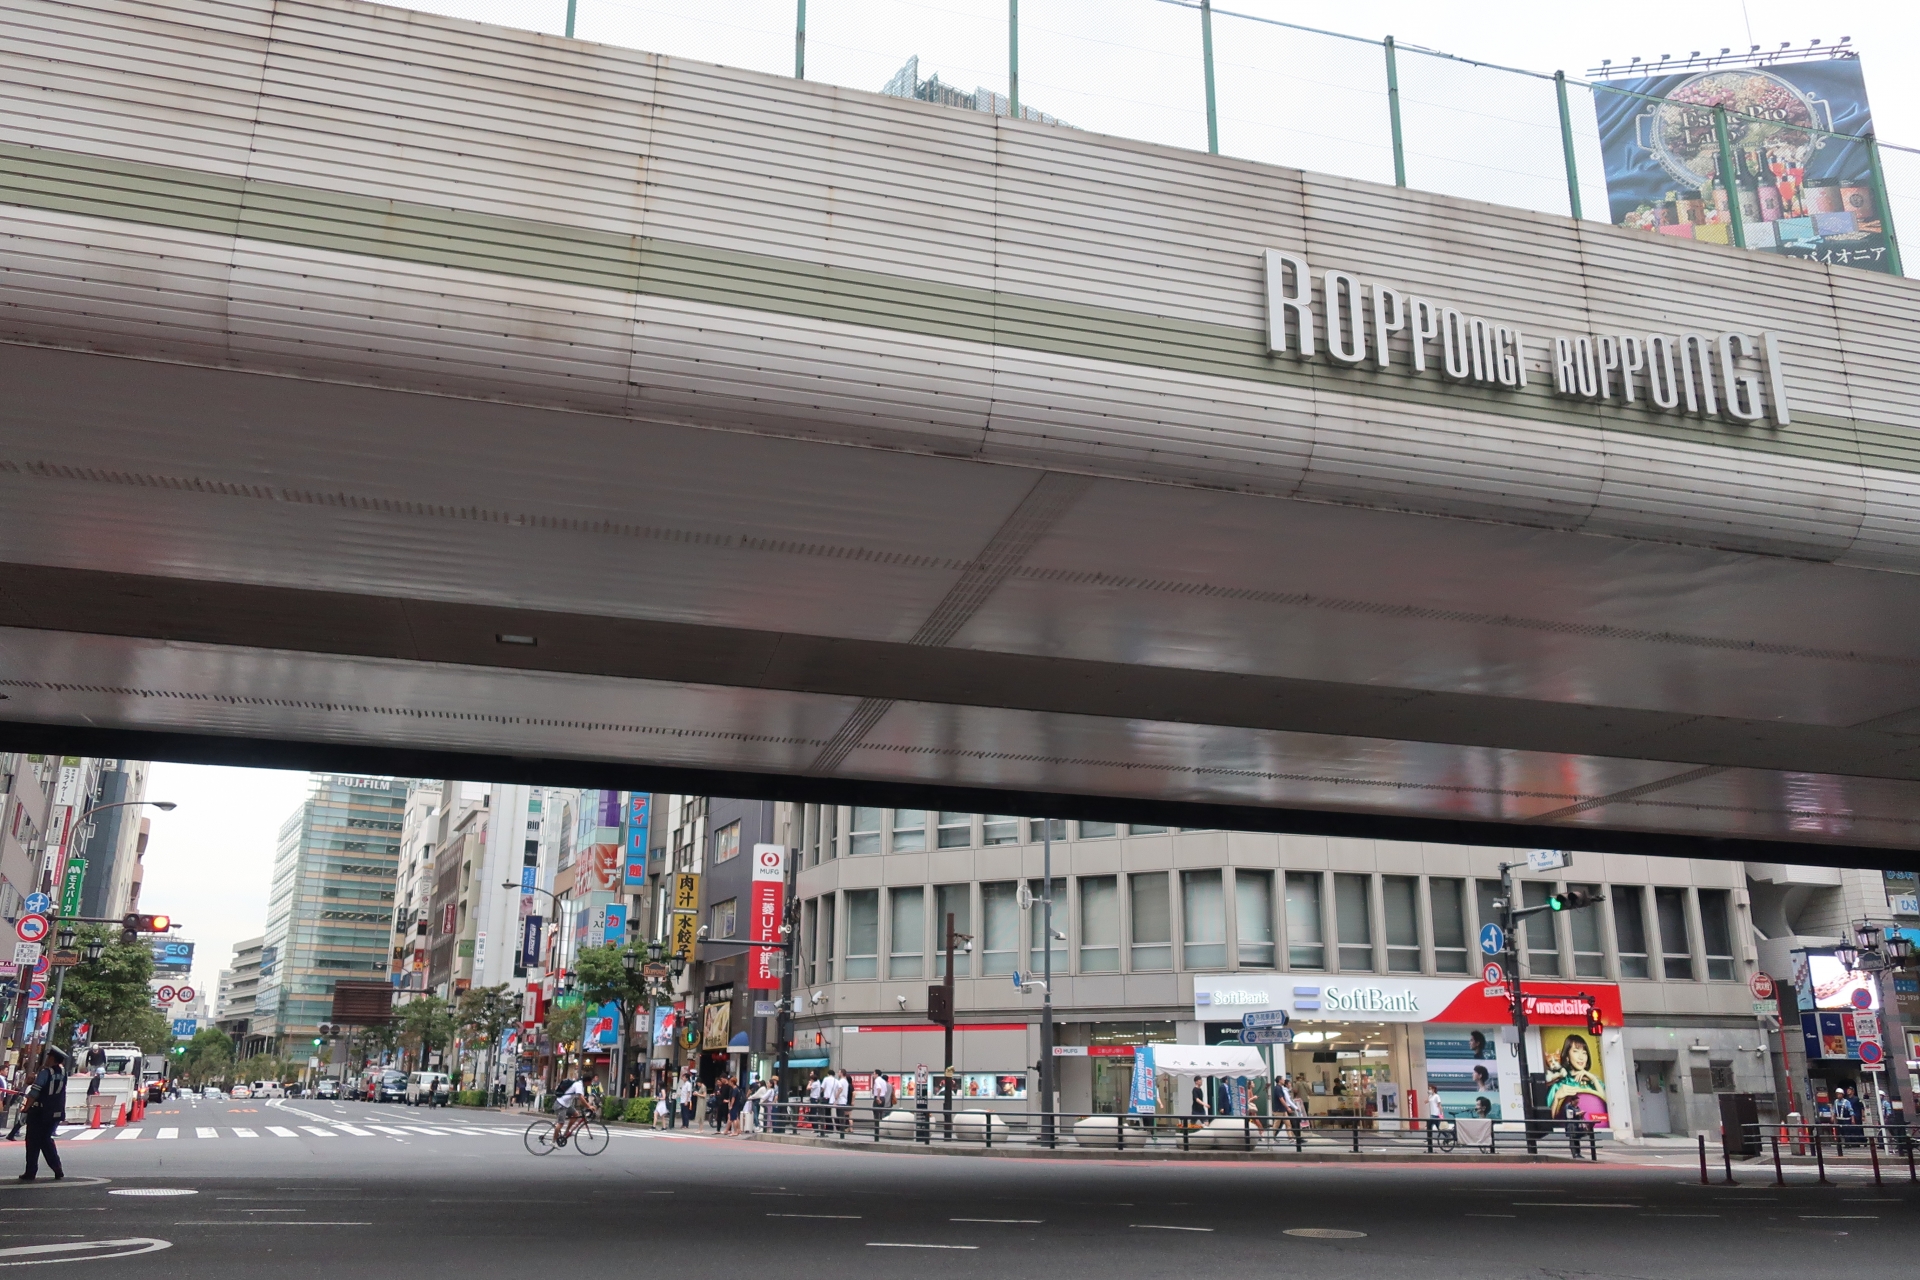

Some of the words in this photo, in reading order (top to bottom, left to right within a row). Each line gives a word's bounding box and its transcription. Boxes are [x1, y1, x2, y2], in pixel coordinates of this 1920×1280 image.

[1787, 247, 1886, 264] パイオニア
[1262, 248, 1527, 389] ROPPONGI
[1550, 331, 1791, 428] ROPPONGI
[337, 776, 390, 791] FUJIFILM
[679, 874, 694, 907] 肉汁
[164, 944, 189, 955] EQ
[181, 990, 191, 999] 40
[1213, 990, 1270, 1006] SoftBank
[1324, 986, 1420, 1013] SoftBank
